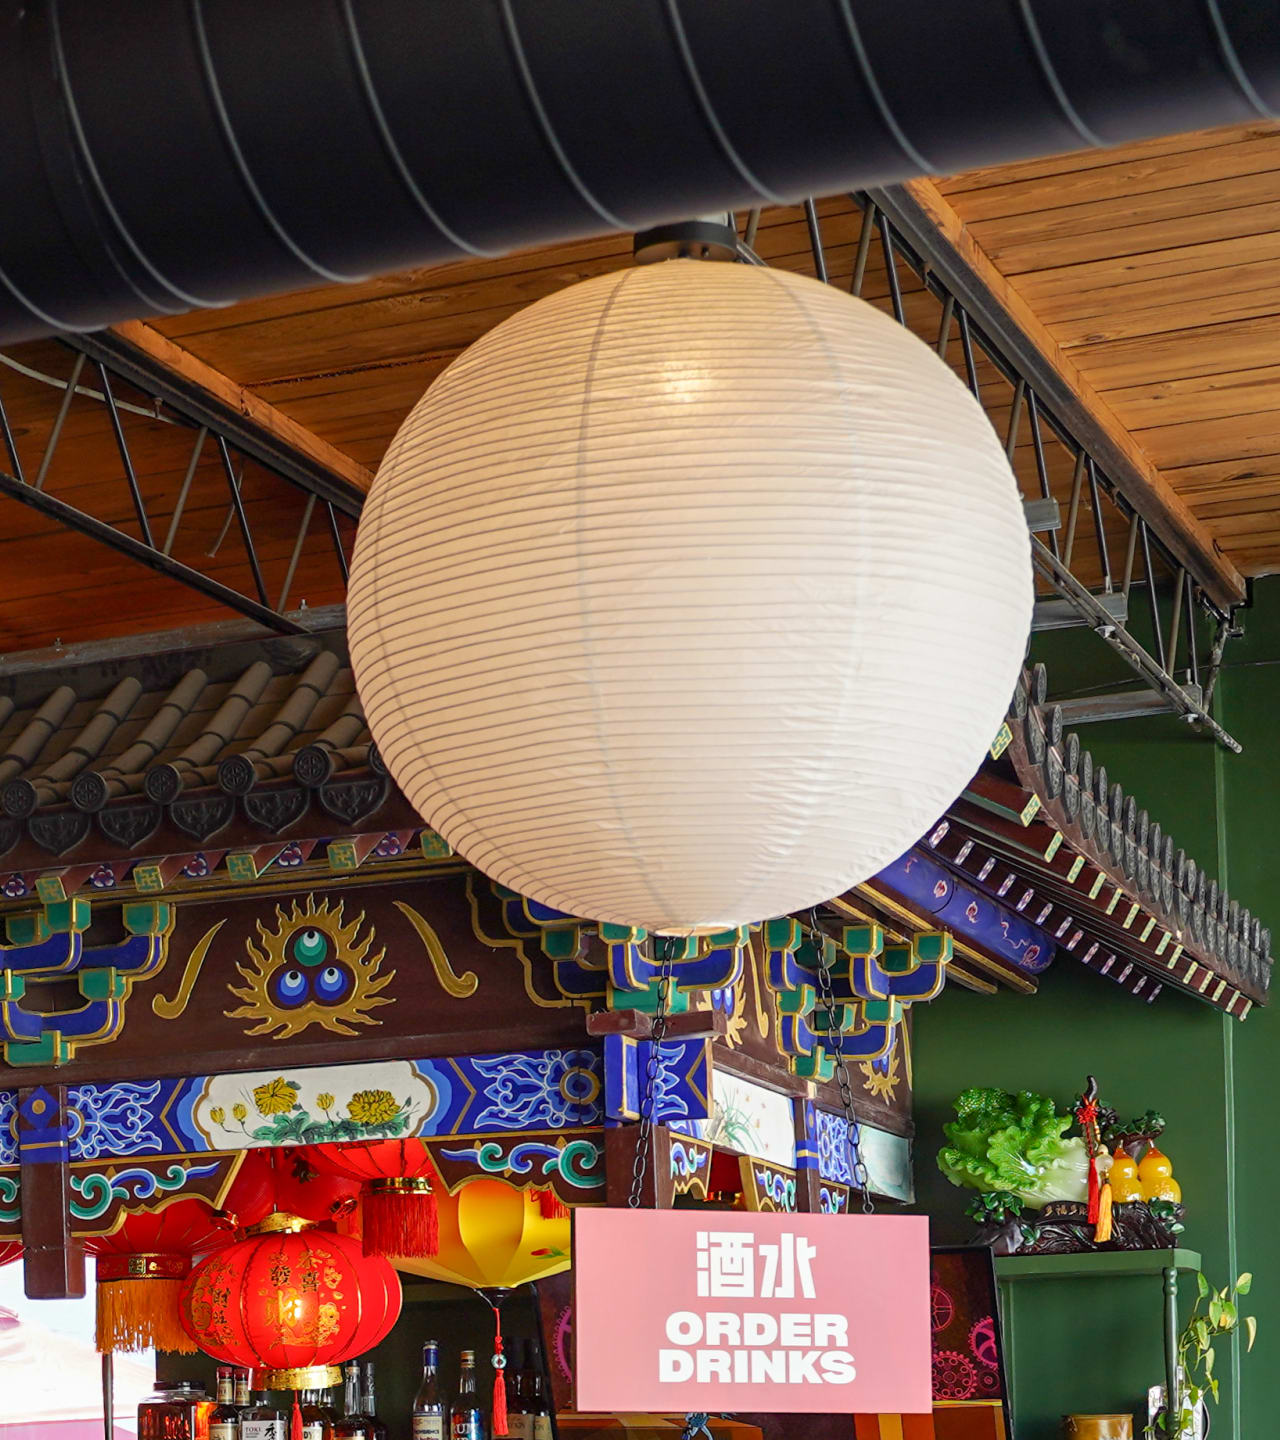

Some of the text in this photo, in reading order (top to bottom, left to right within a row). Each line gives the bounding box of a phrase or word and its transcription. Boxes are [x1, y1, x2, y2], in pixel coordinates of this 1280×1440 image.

[696, 1231, 817, 1299] 酒水
[665, 1311, 849, 1347] ORDER
[658, 1349, 857, 1385] DRINKS
